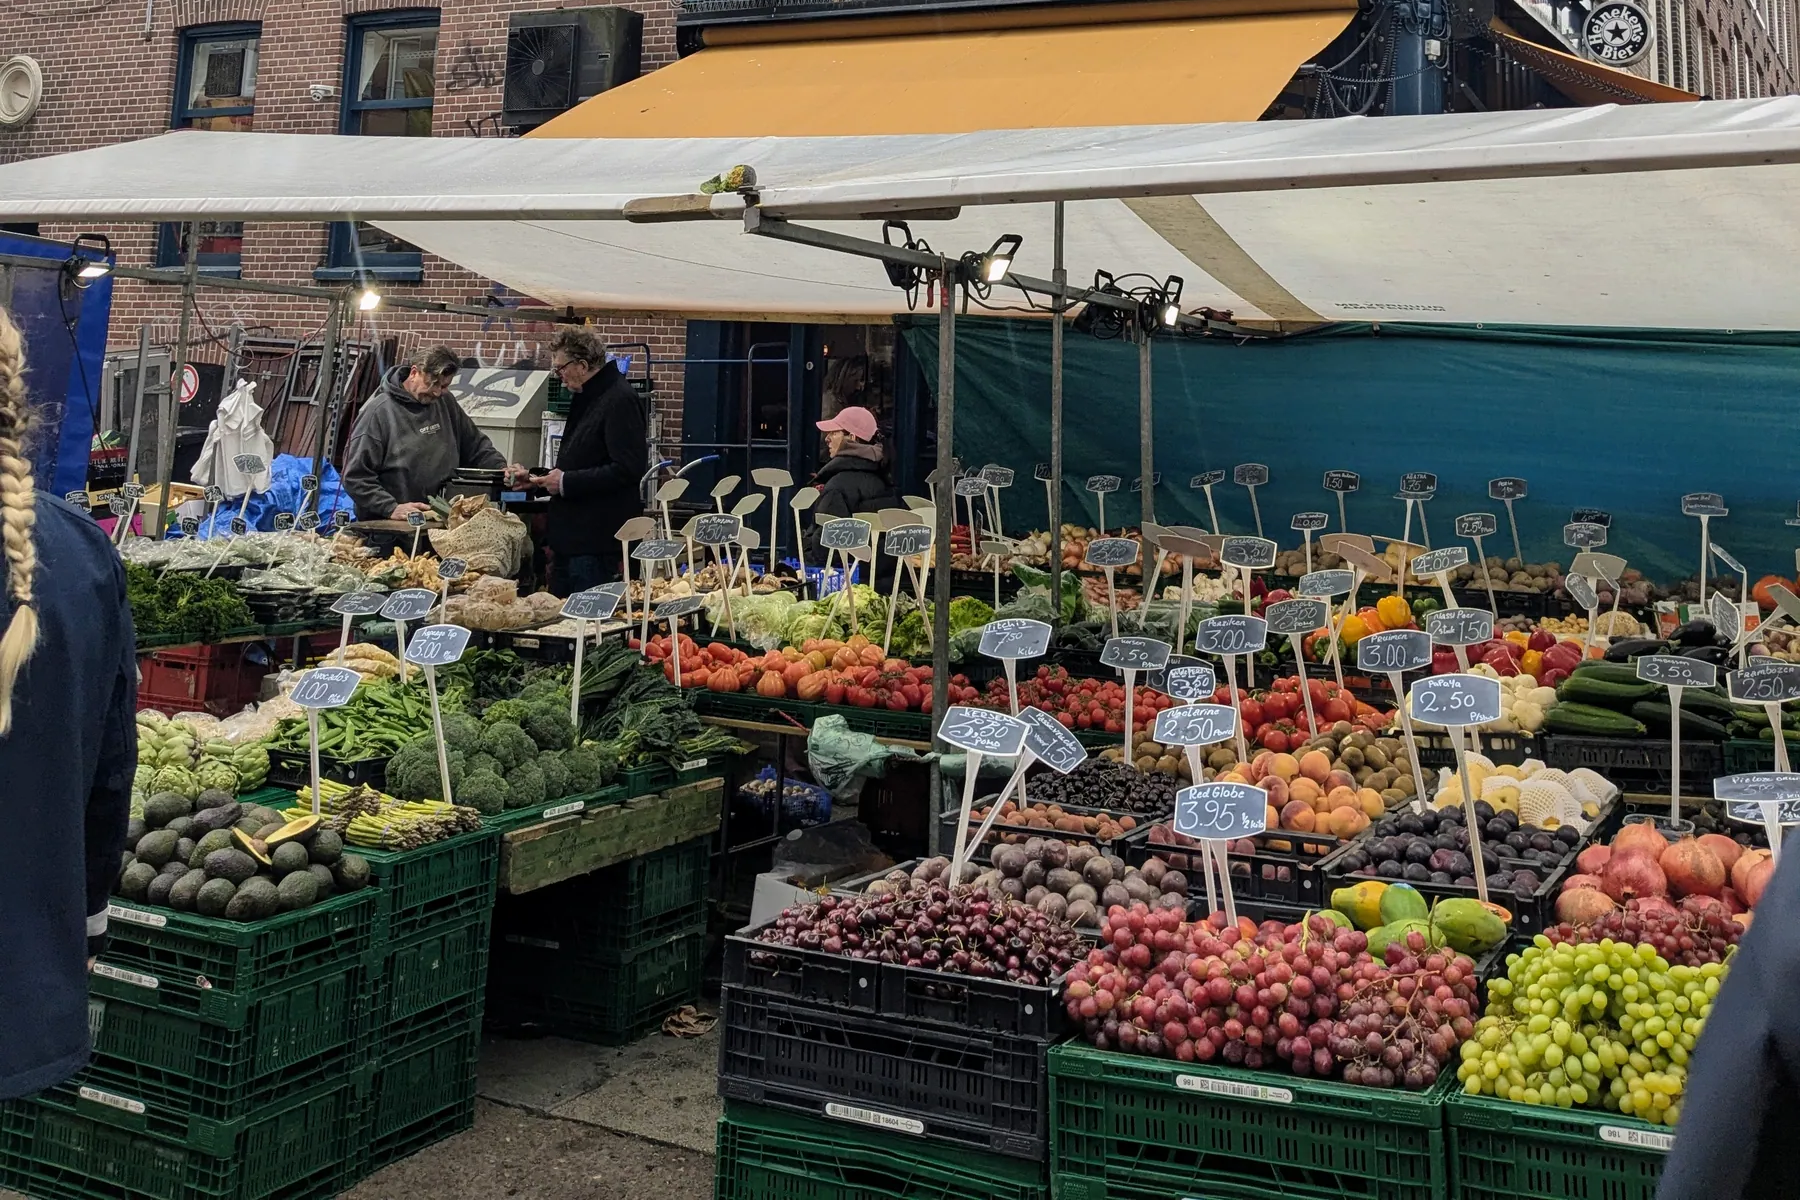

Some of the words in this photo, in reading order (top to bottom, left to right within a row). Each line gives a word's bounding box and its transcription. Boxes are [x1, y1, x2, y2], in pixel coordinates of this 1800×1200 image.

[1588, 6, 1644, 45] Heineken's
[1601, 45, 1634, 59] Bier
[1326, 477, 1343, 489] 1.50
[1403, 480, 1422, 490] 1.75
[696, 524, 723, 541] 3.50
[826, 530, 854, 546] 3.50
[887, 537, 915, 555] 4.00
[1416, 557, 1450, 573] 4.00
[386, 600, 412, 615] 6.00
[567, 600, 594, 615] 1.50
[1202, 629, 1245, 650] 3.00
[1459, 620, 1490, 642] 1.50
[409, 640, 441, 659] 3.00
[1363, 644, 1406, 668] 3.00
[296, 680, 328, 700] 1.00
[1742, 678, 1784, 699] 2.50
[1163, 718, 1214, 742] 2.50
[1042, 738, 1077, 770] 1.50
[1189, 787, 1209, 800] Red
[1212, 786, 1245, 798] Globe
[1179, 800, 1236, 831] 3.95
